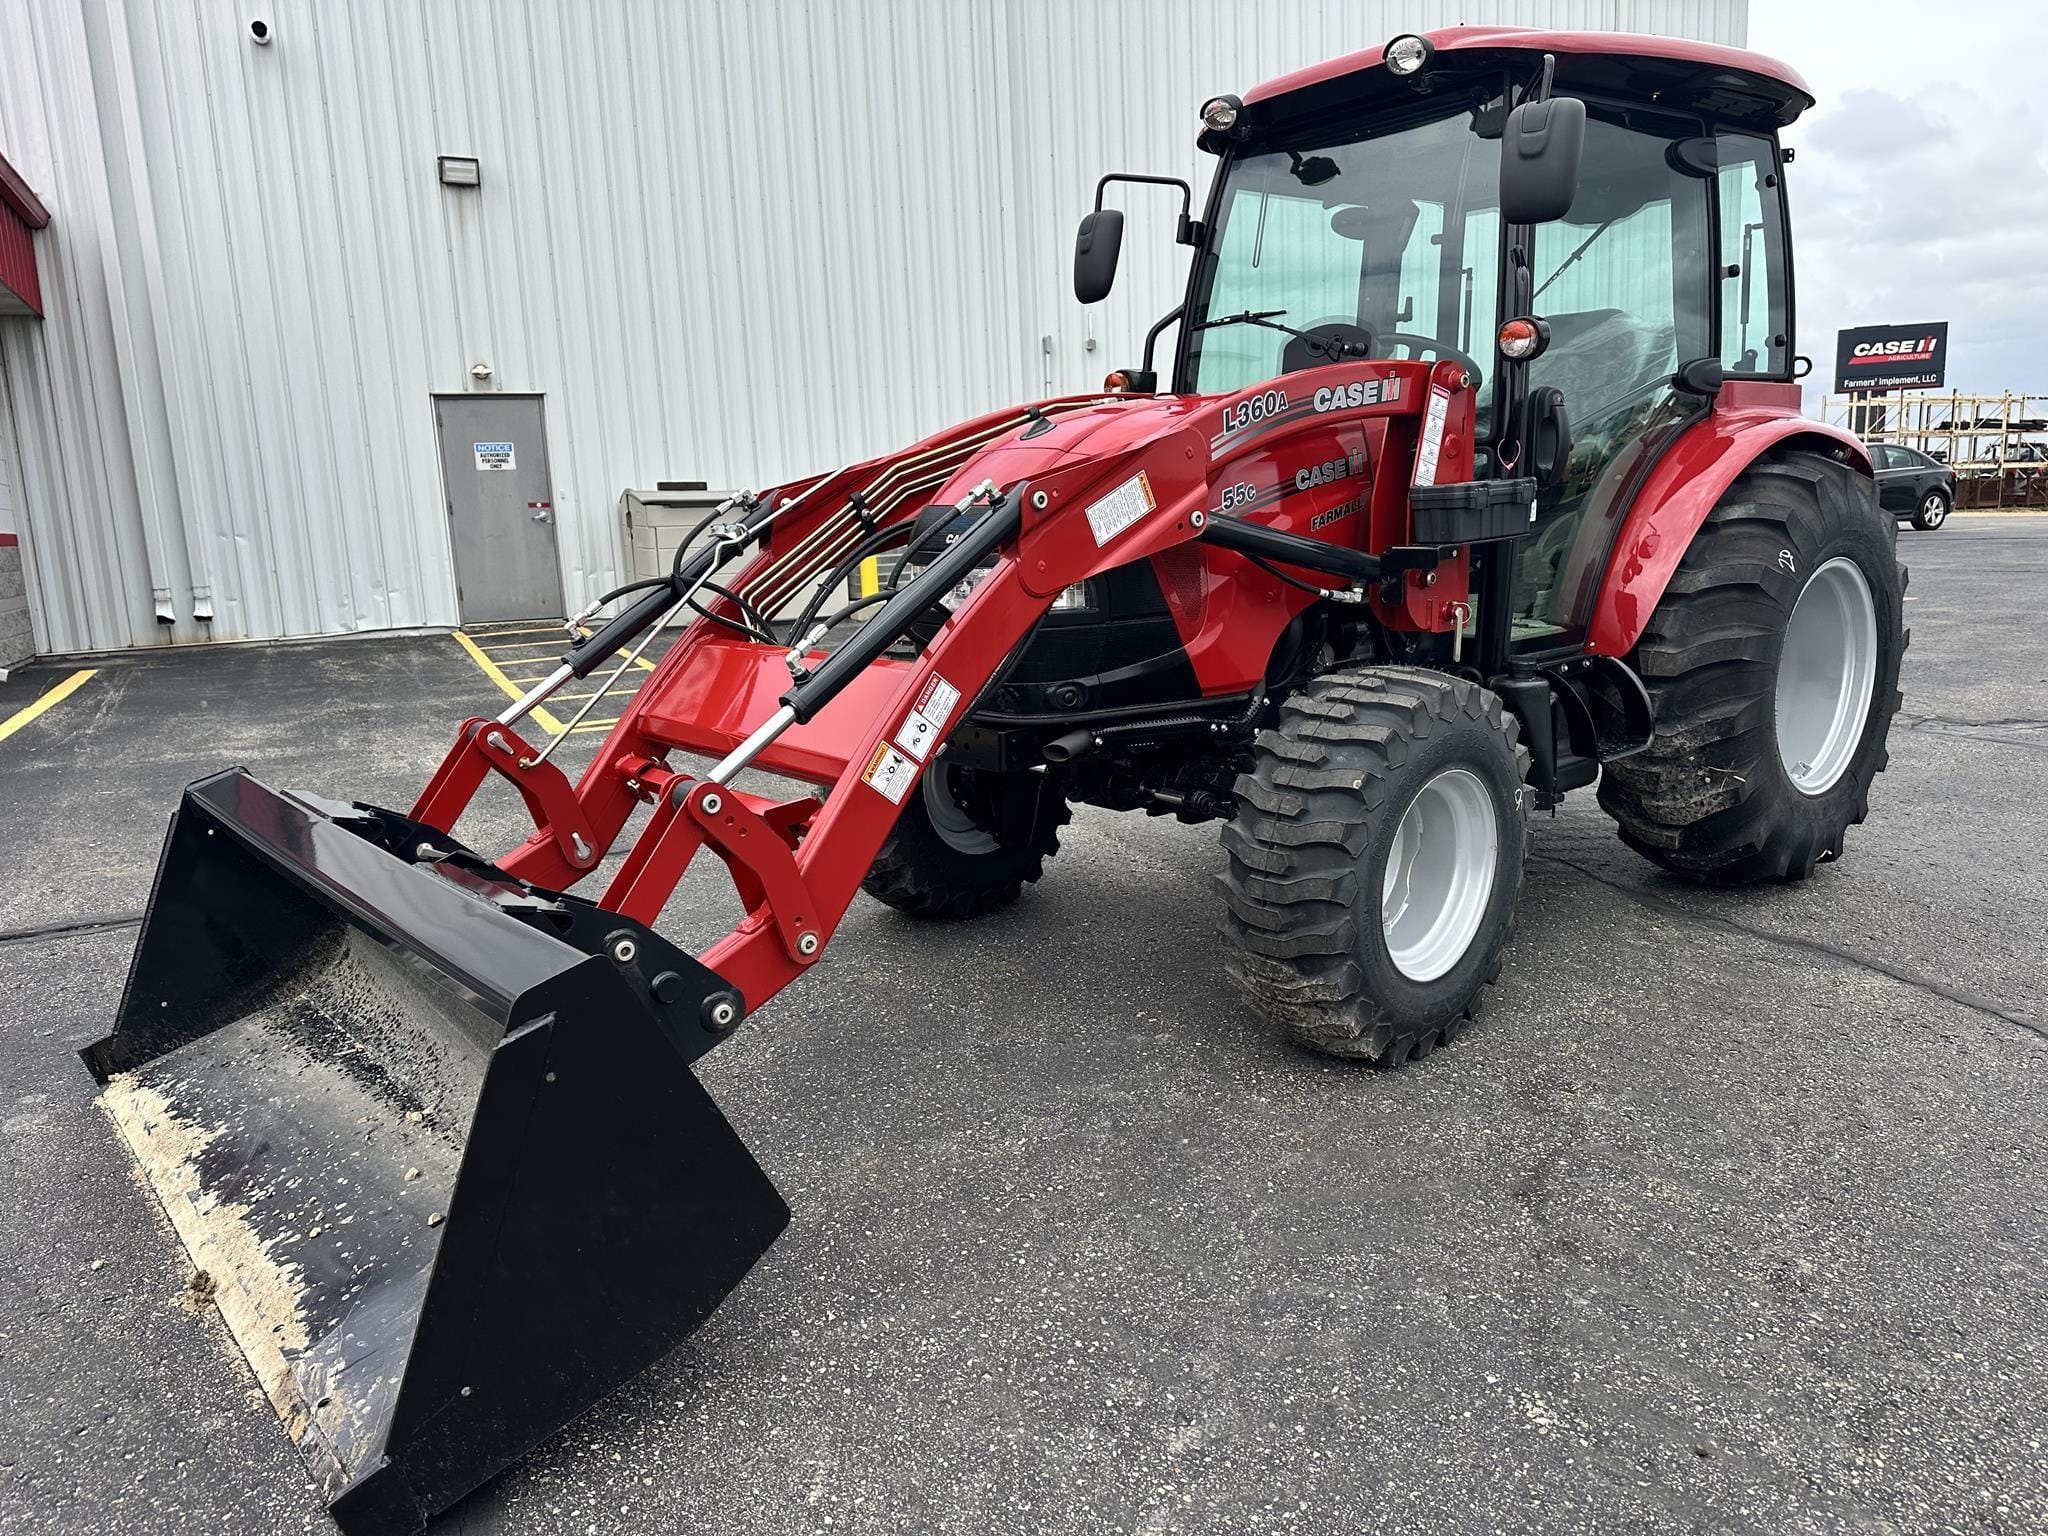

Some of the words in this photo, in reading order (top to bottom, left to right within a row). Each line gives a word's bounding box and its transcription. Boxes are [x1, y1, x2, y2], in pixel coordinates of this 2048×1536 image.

[1853, 339, 1915, 357] CASE
[1887, 352, 1931, 362] AGRICULTURE
[1313, 378, 1380, 413] CASE
[1844, 377, 1878, 388] Farmers'
[1879, 375, 1921, 387] Implement,
[1922, 374, 1937, 383] LLC
[1222, 390, 1289, 436] L360A
[1295, 458, 1347, 491] CASE
[1311, 499, 1365, 532] FARMALL
[921, 676, 940, 704] DANGER
